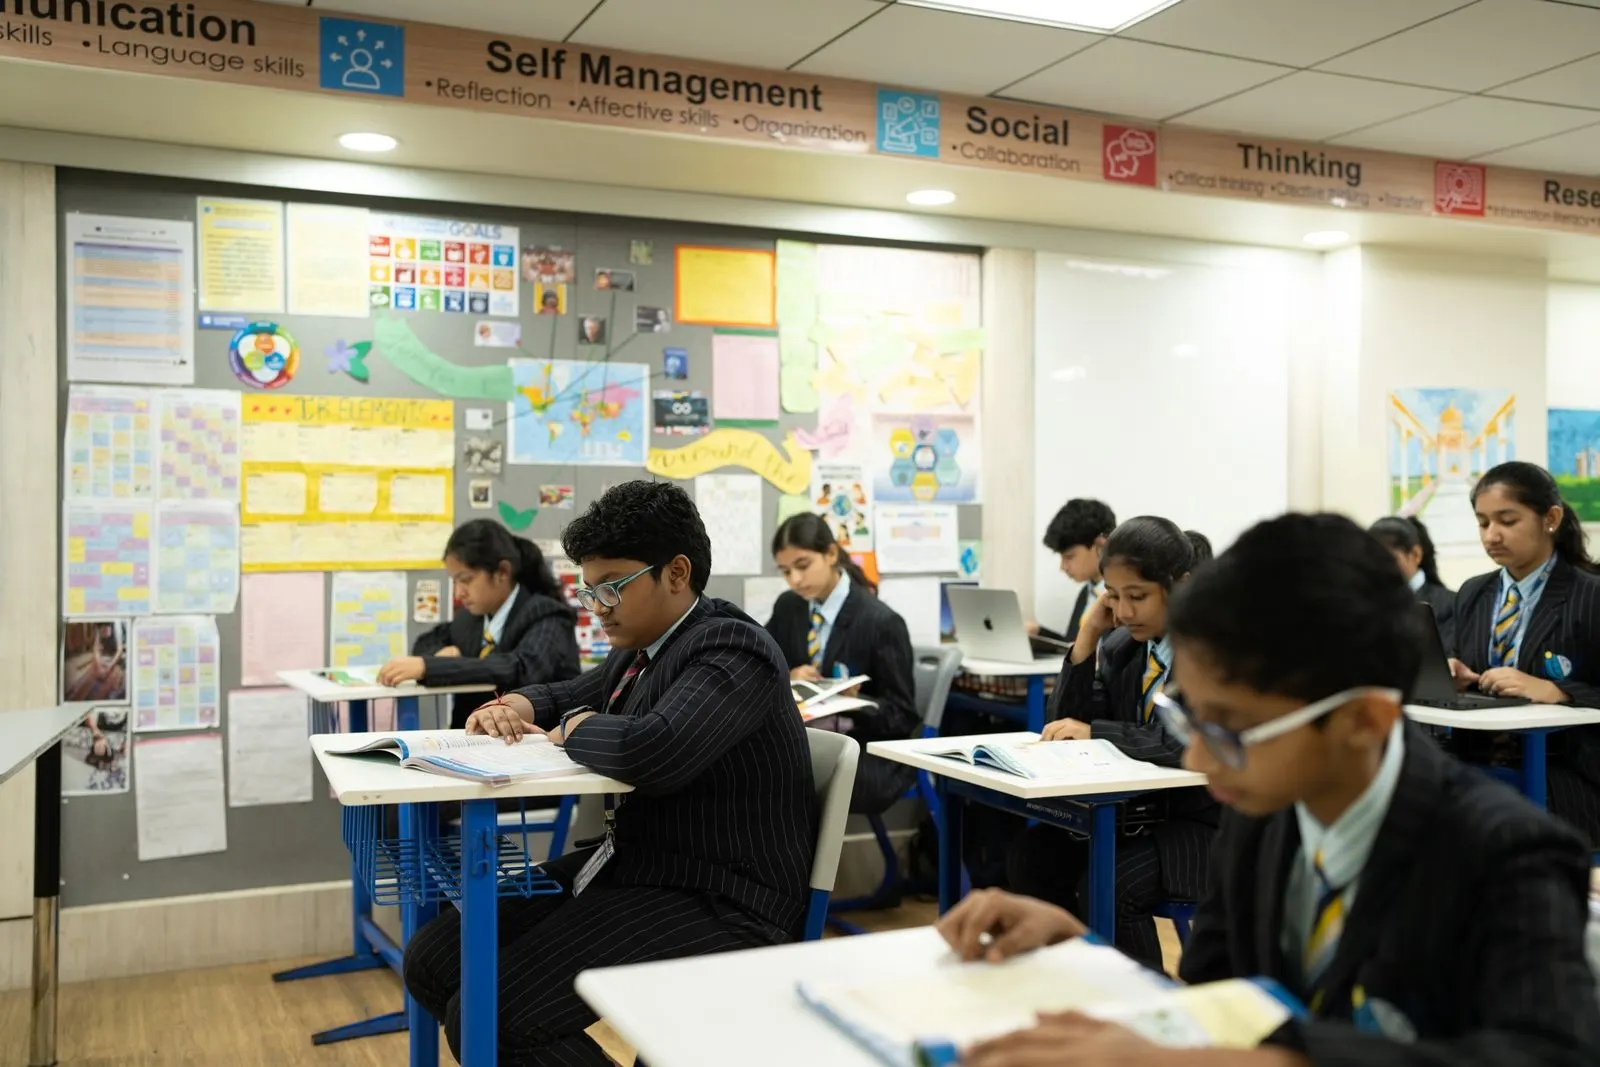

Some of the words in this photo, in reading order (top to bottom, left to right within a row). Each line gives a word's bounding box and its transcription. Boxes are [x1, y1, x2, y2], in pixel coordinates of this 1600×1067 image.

[0, 0, 255, 46] unication
[98, 34, 244, 72] Language
[253, 55, 305, 78] skills
[437, 78, 551, 109] Reflection
[486, 40, 567, 80] Self
[580, 52, 822, 112] Management
[577, 96, 673, 122] Affective
[680, 107, 720, 128] skills
[742, 113, 867, 142] Organization
[966, 105, 1069, 147] Social
[960, 141, 1080, 171] Collaboration
[1236, 142, 1361, 187] Thinking
[449, 220, 502, 240] GOALS
